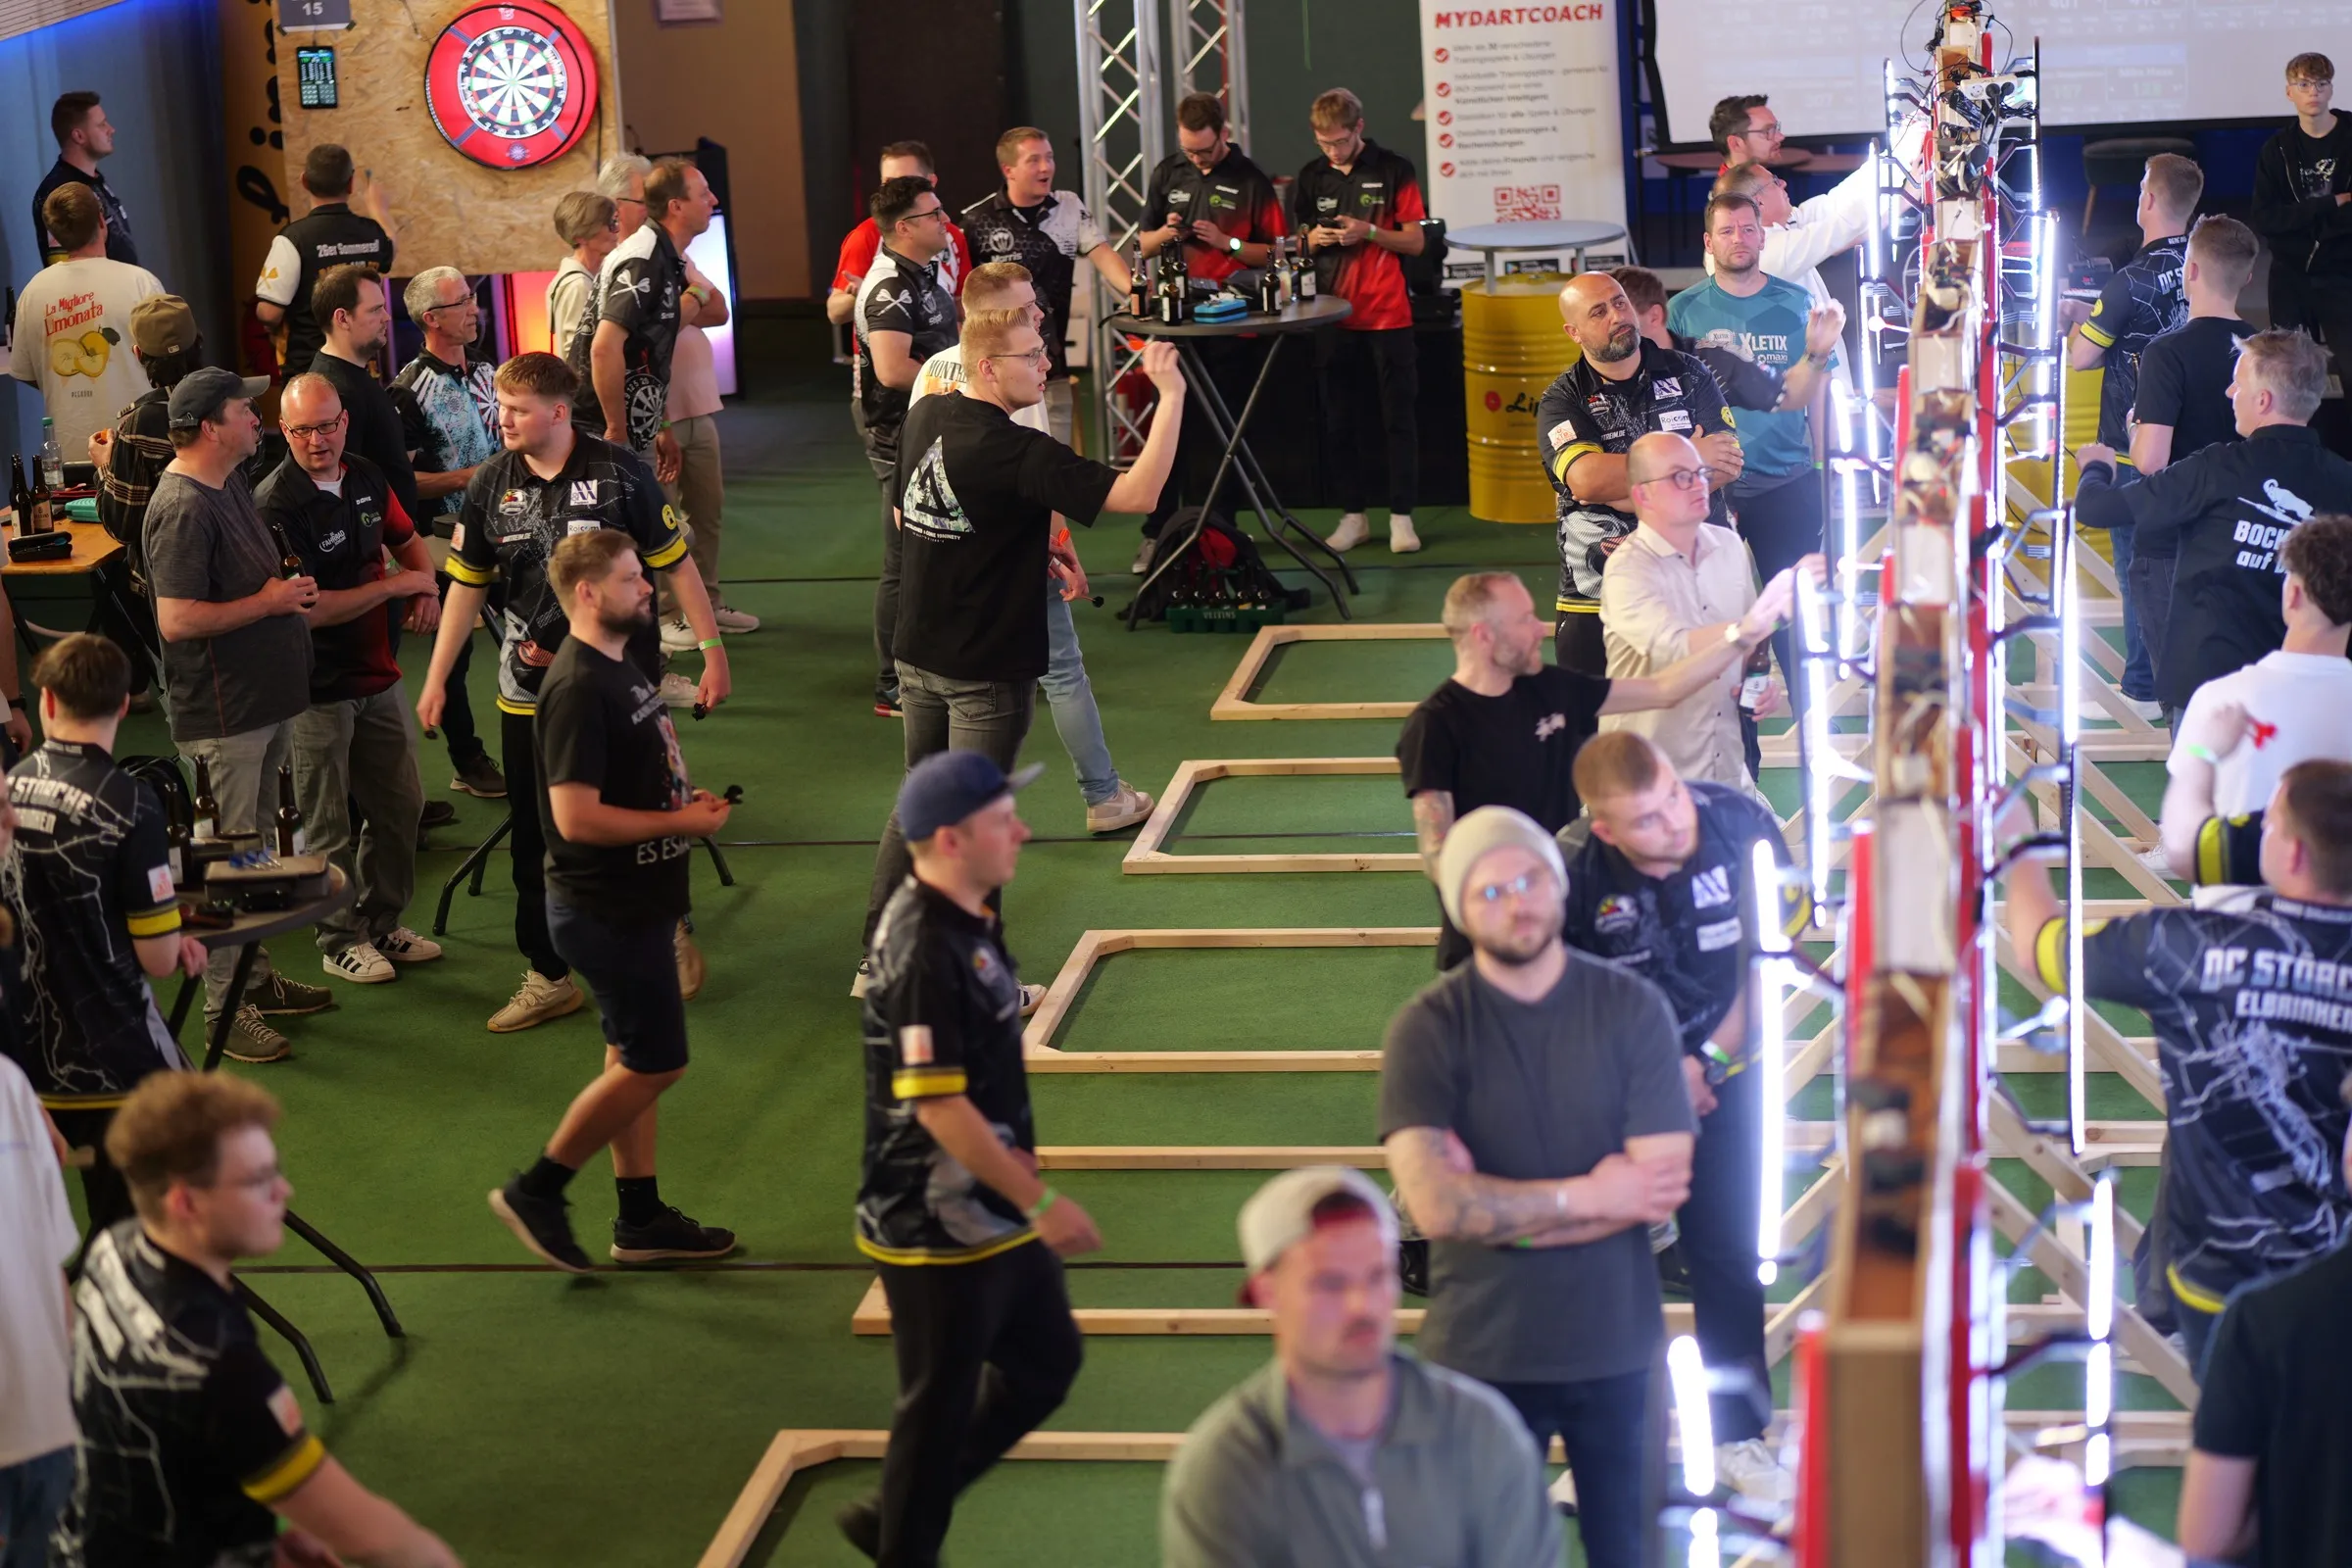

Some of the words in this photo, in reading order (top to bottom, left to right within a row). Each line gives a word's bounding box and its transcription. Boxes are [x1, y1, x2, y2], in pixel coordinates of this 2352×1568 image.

[302, 2, 323, 16] 15
[1435, 4, 1603, 28] MYDARTCOACH
[2157, 270, 2176, 295] DC
[45, 304, 57, 317] La
[59, 292, 95, 312] Migliore
[44, 301, 104, 337] Limonata
[1739, 332, 1788, 354] XLETIX
[2236, 551, 2274, 570] auf
[637, 841, 658, 864] ES
